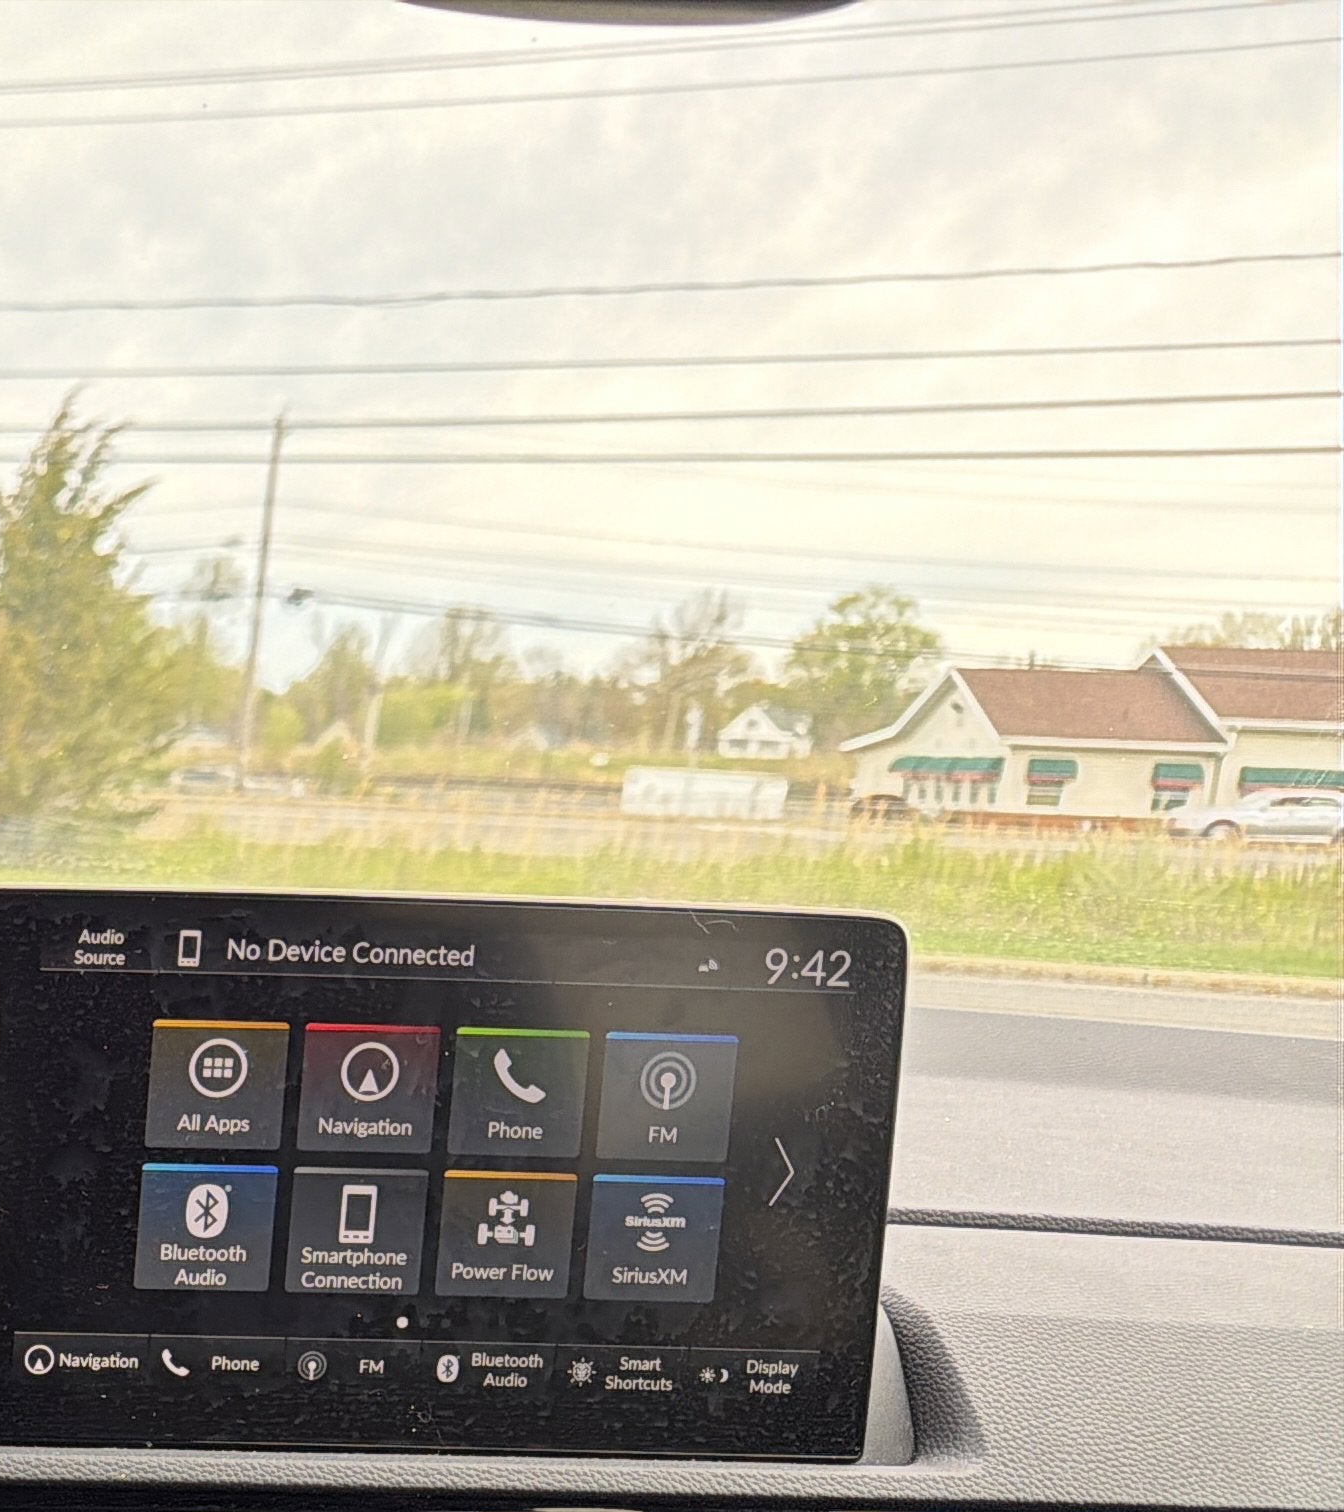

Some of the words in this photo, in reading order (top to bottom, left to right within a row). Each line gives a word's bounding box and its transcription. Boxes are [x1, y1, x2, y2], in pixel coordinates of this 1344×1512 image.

[78, 929, 125, 945] Audio
[74, 950, 125, 966] Source
[227, 939, 263, 961] No
[267, 940, 346, 963] Device
[353, 943, 475, 967] Connected
[765, 948, 852, 988] 9:42
[177, 1114, 201, 1132] All
[205, 1115, 250, 1135] Apps
[318, 1116, 412, 1138] Navigation
[488, 1121, 543, 1140] Phone
[648, 1127, 678, 1144] FM
[160, 1243, 247, 1262] Bluetooth
[301, 1247, 408, 1269] Smartphone
[174, 1269, 227, 1286] Audio
[301, 1272, 403, 1290] Connection
[451, 1263, 507, 1281] Power
[511, 1264, 554, 1282] Flow
[612, 1267, 688, 1286] SiriusXM
[59, 1352, 139, 1372] Navigation
[211, 1356, 260, 1372] Phone
[359, 1360, 385, 1374] FM
[471, 1353, 543, 1369] Bluetooth
[620, 1357, 661, 1373] Smart
[746, 1360, 800, 1378] Display
[483, 1373, 528, 1388] Audio
[605, 1376, 673, 1392] Shortcuts
[750, 1380, 791, 1395] Mode
